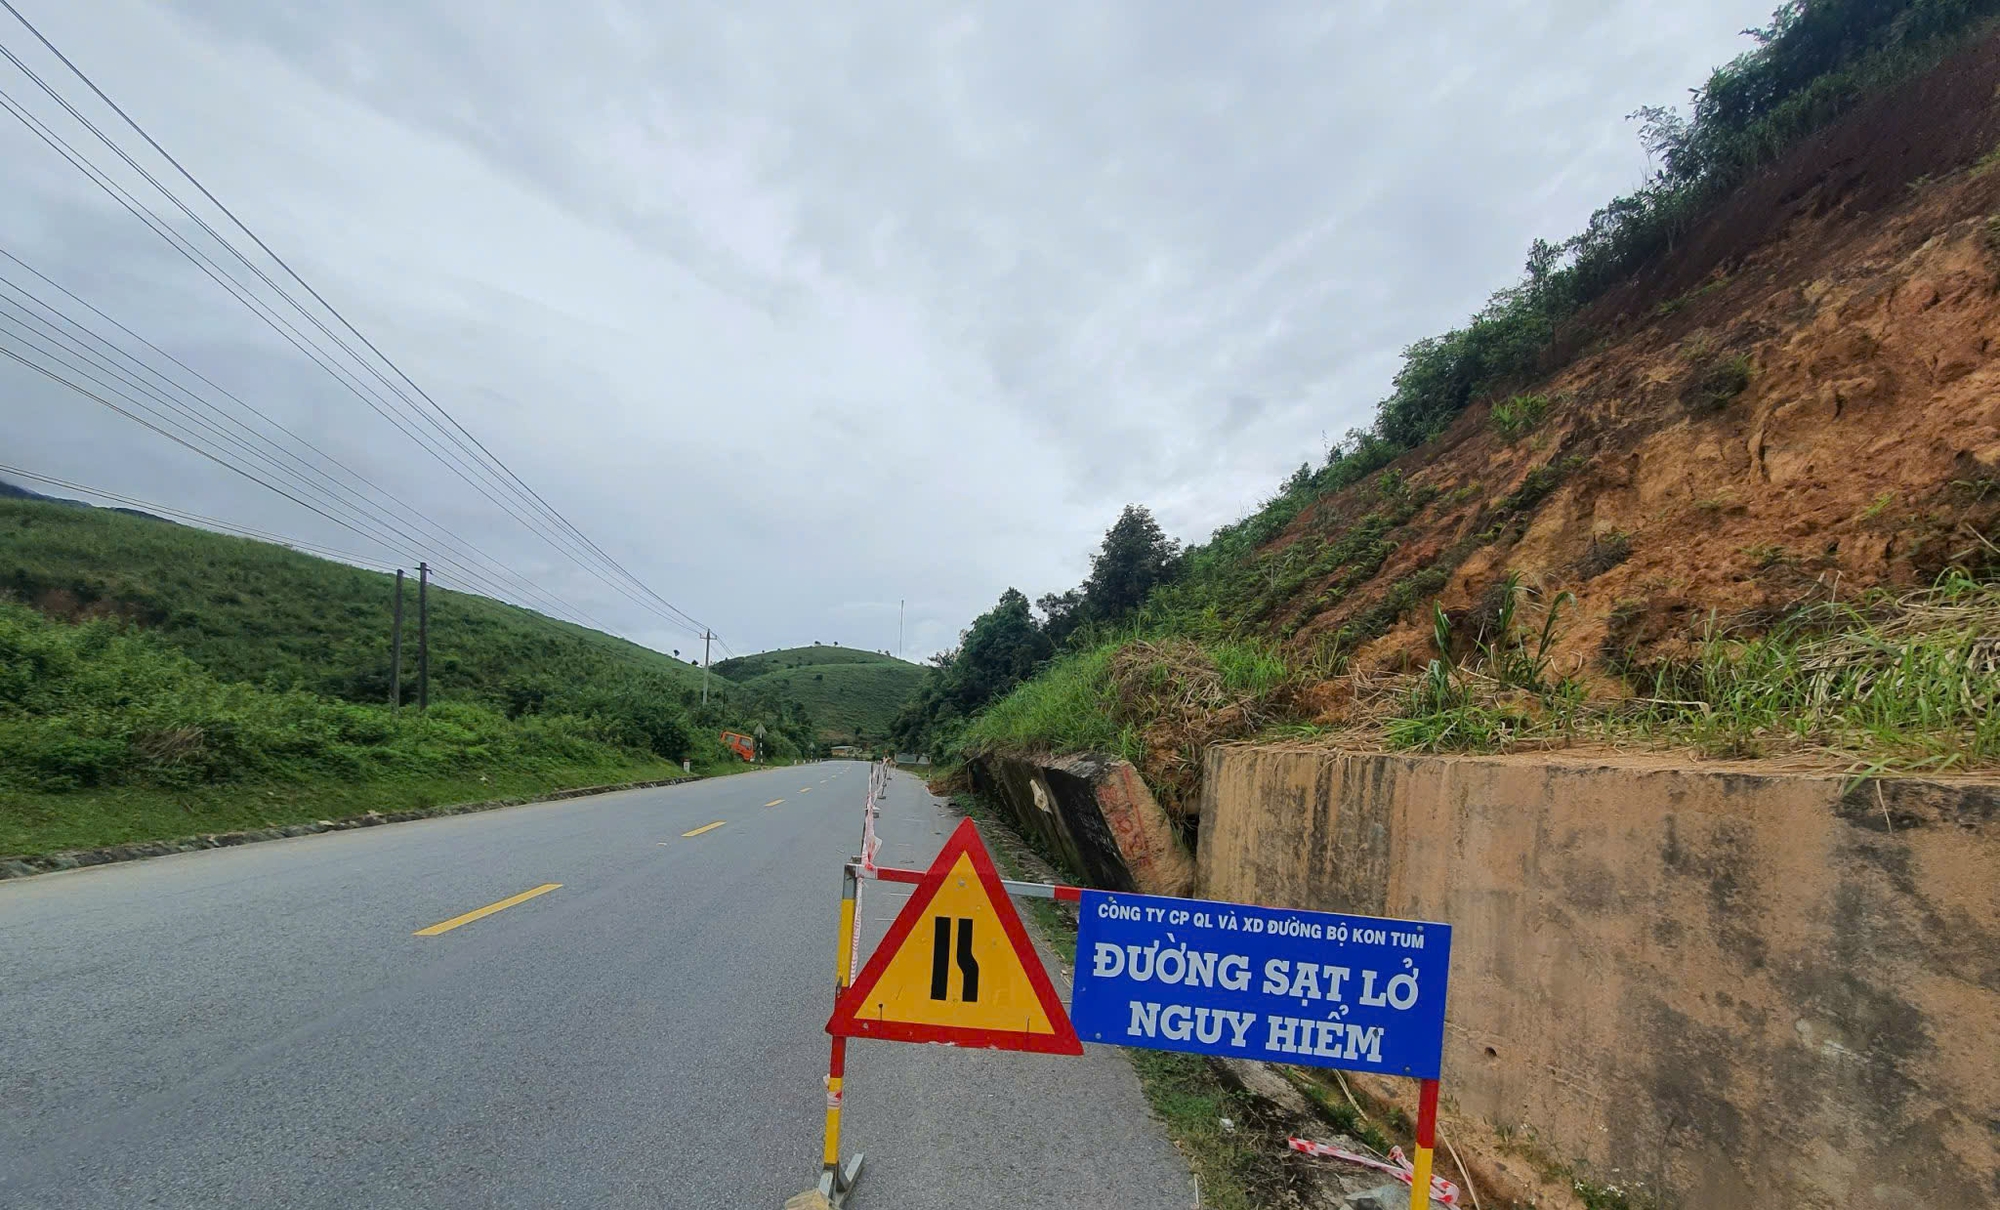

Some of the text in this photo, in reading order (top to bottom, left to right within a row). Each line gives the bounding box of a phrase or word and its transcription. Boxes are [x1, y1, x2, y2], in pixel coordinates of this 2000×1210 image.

[1098, 900, 1424, 949] CÔNG TY CP QL VÀ XD ĐƯỜNG BỘ KON TUM
[1093, 932, 1418, 1010] ĐƯỜNG SẠT LỞ
[1127, 1000, 1384, 1063] NGUY HIỂM
